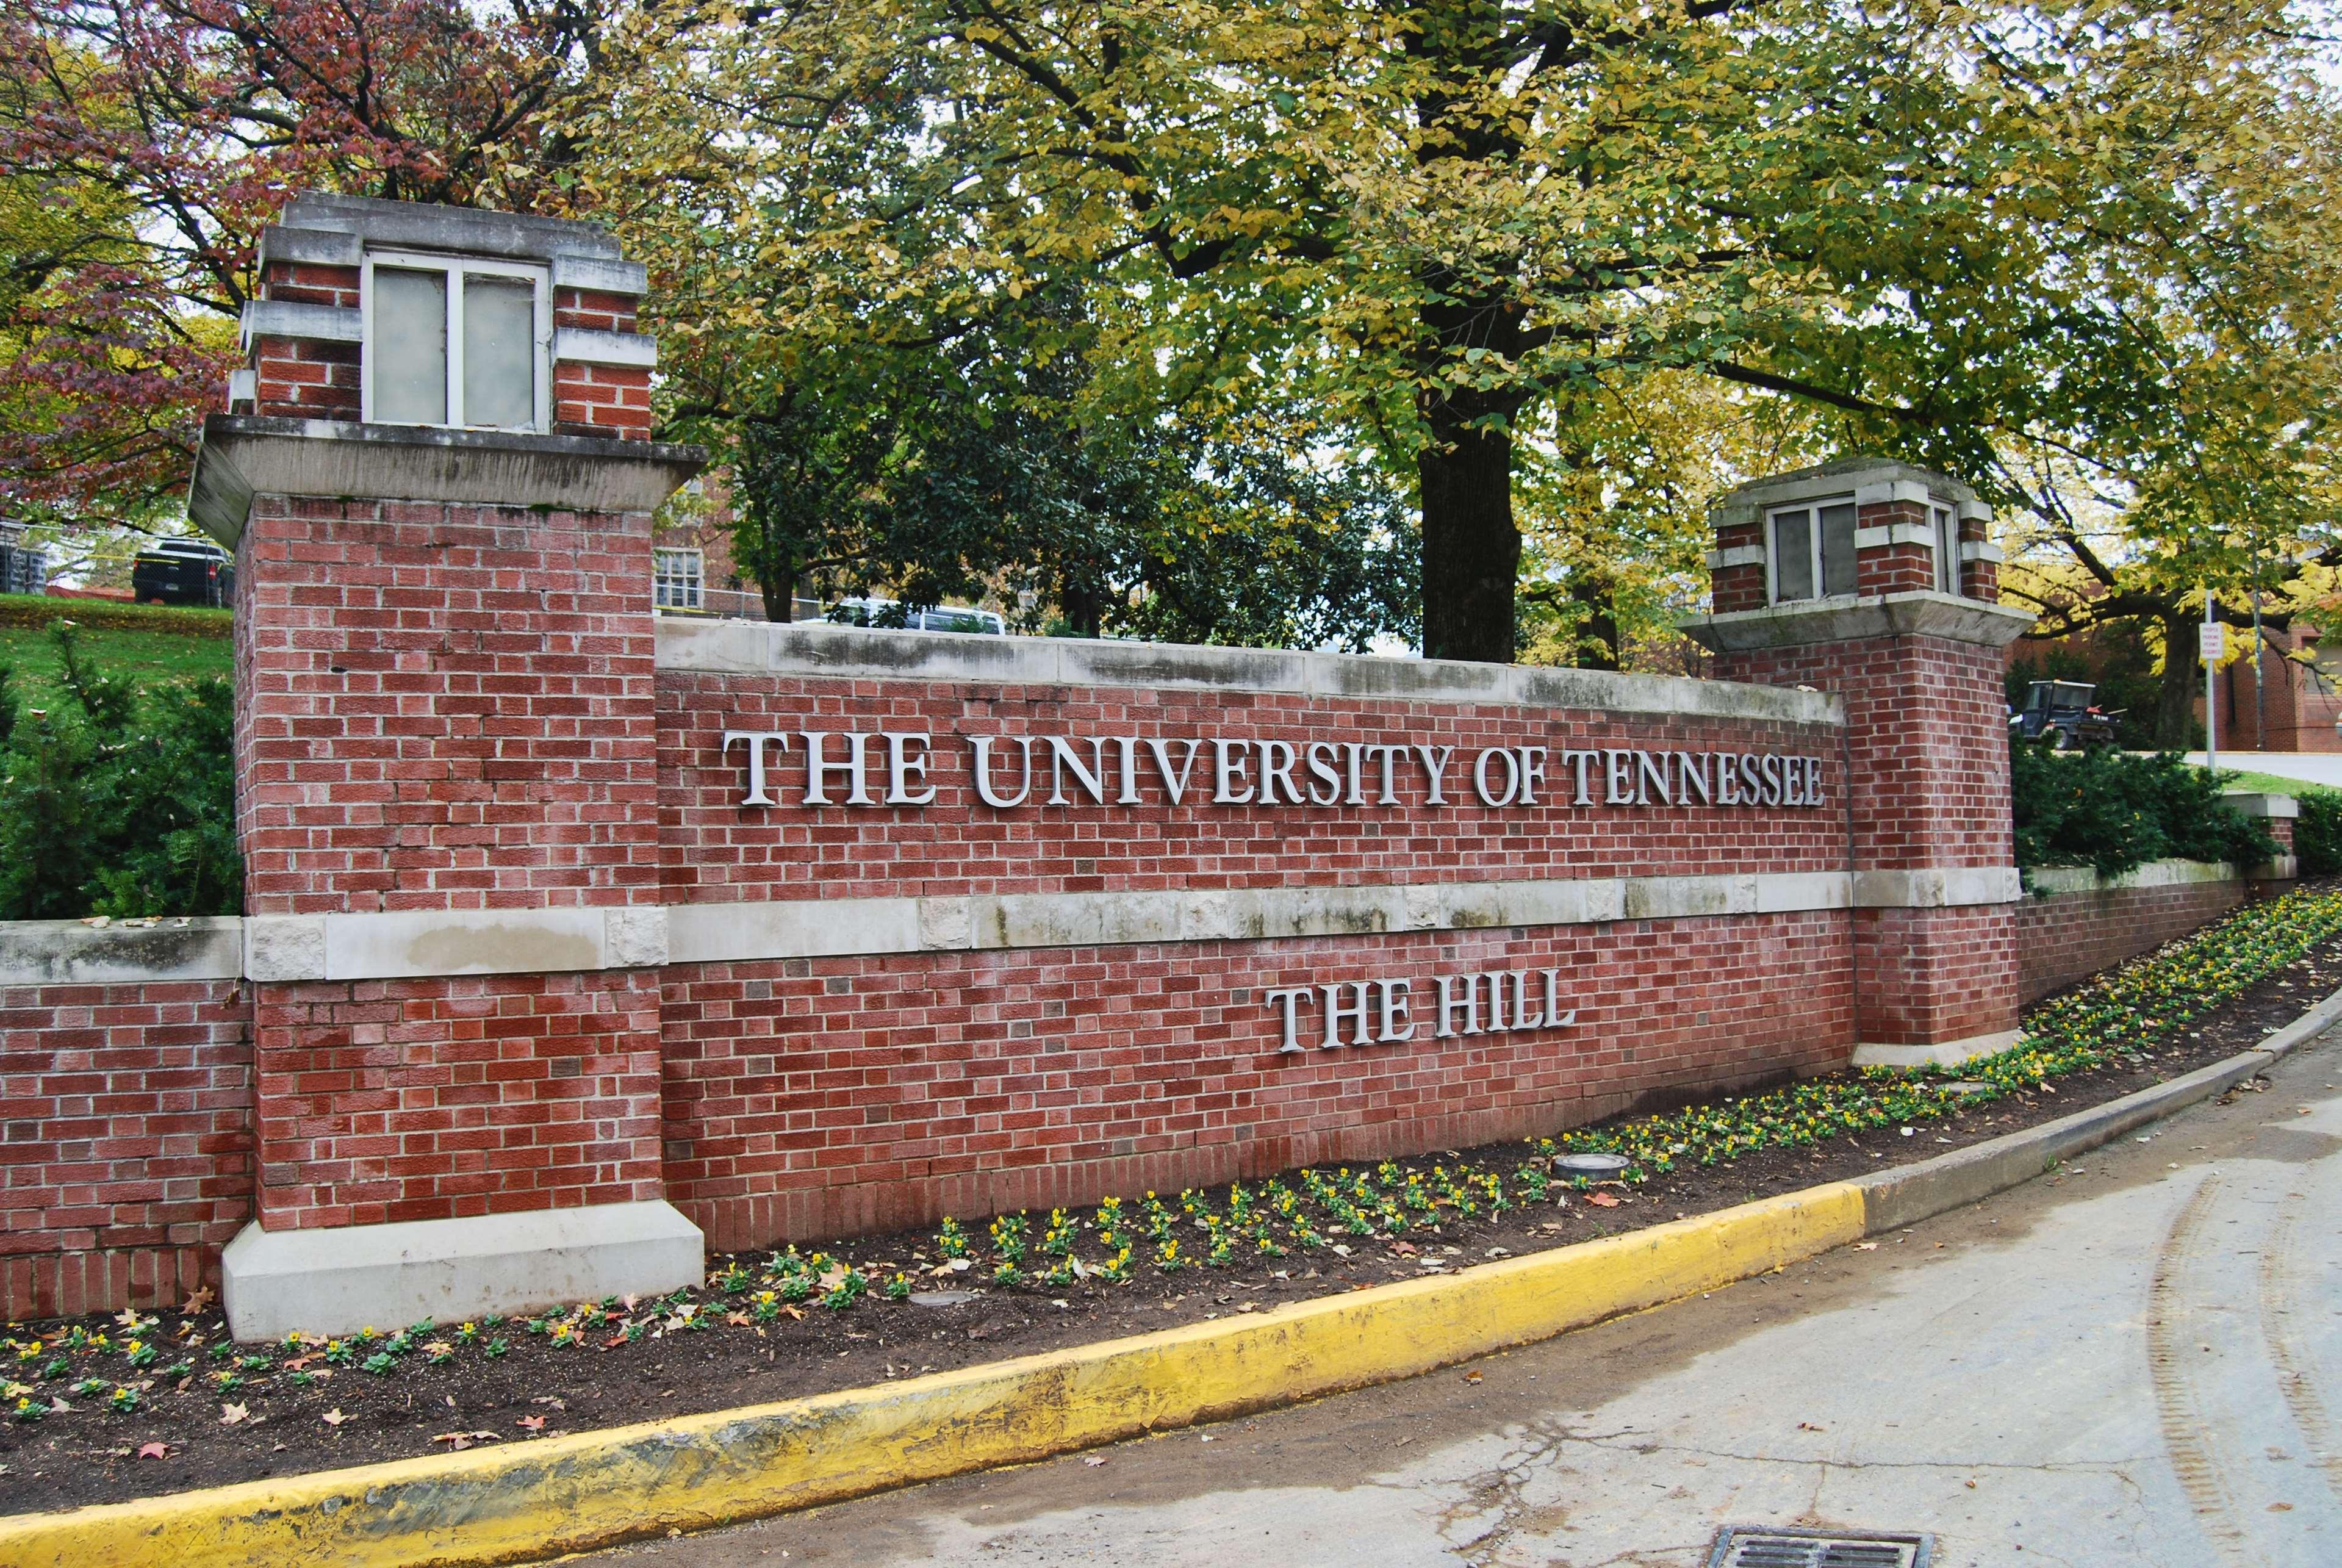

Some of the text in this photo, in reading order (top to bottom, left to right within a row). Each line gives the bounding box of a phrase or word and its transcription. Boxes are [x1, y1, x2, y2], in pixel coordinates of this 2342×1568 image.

[722, 732, 1825, 808] THE UNIVERSITY OF TENNESSEE
[1265, 969, 1576, 1052] THE HILL
